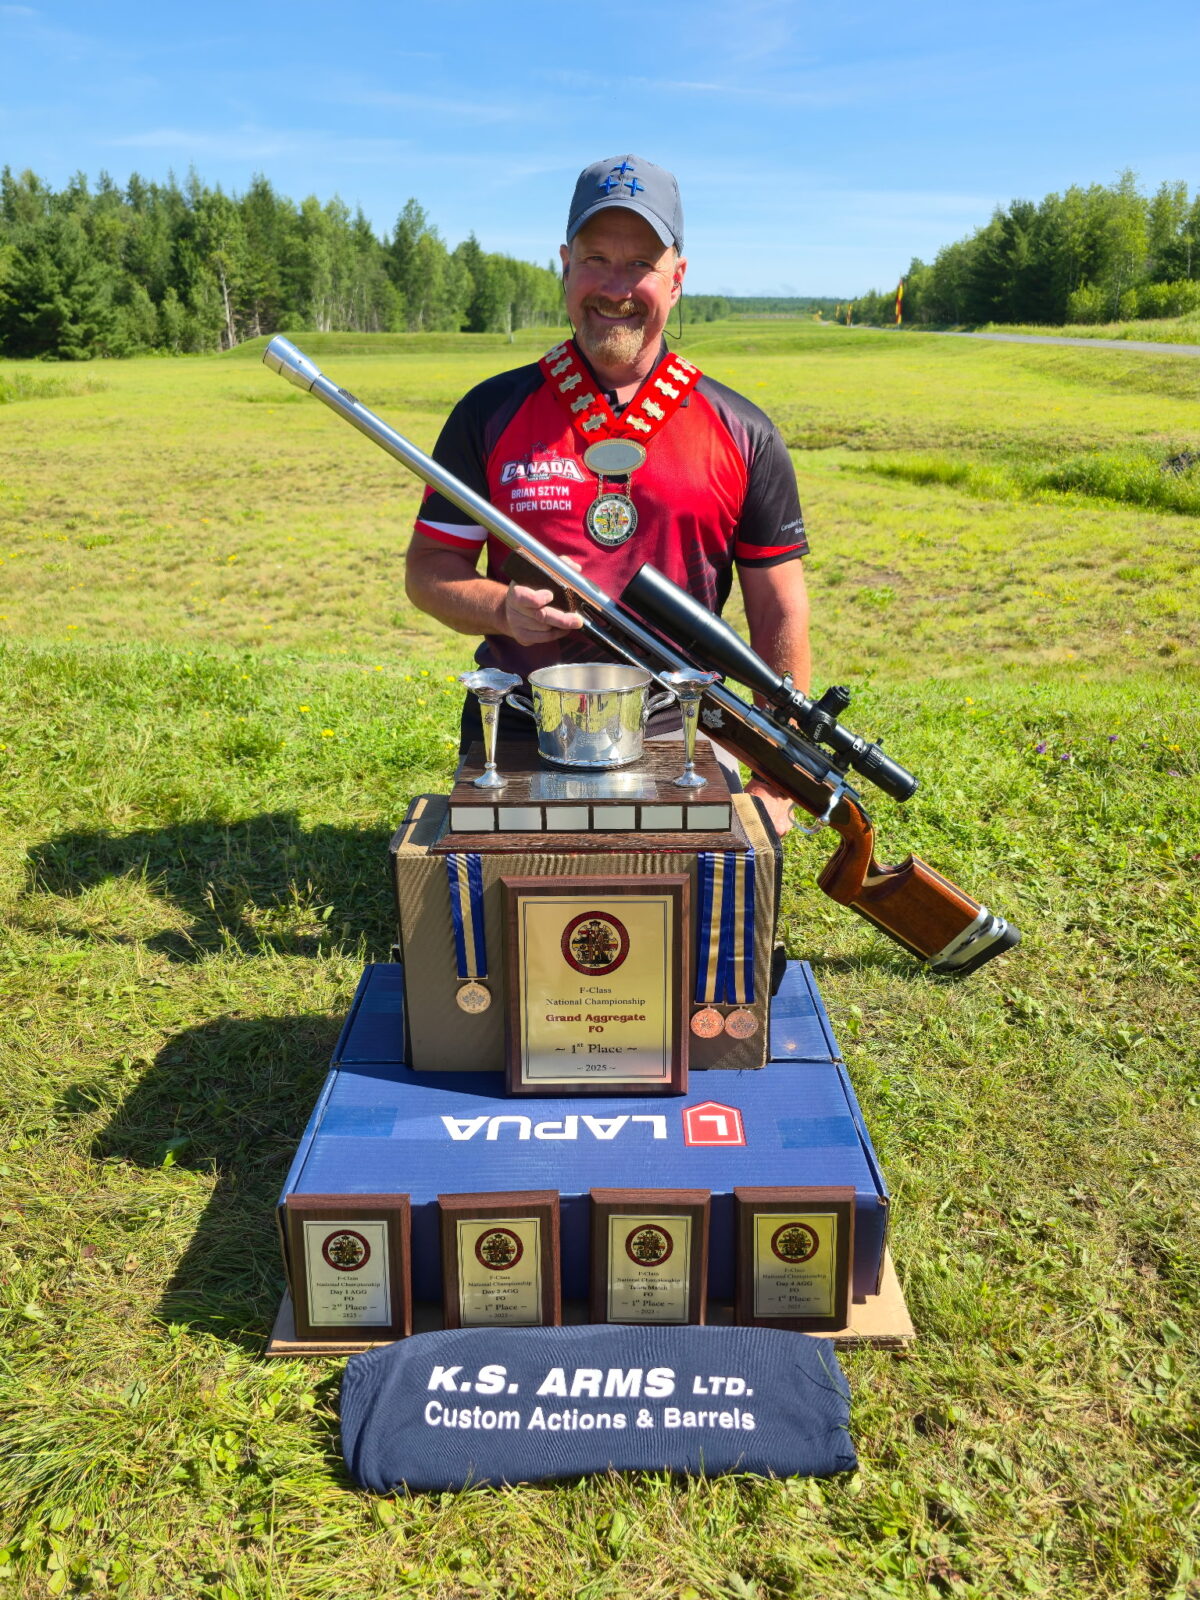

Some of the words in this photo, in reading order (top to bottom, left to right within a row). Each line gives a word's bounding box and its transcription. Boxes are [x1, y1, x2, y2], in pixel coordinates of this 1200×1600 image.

[501, 459, 584, 485] CANADA
[511, 487, 535, 499] BRIAN
[538, 486, 570, 497] SZTYM
[510, 503, 515, 513] F
[516, 501, 537, 512] OPEN
[540, 500, 572, 511] COACH
[579, 986, 612, 994] F-Class
[546, 998, 582, 1006] National
[584, 997, 646, 1007] Championship
[546, 1014, 582, 1022] Grand
[585, 1014, 646, 1024] Aggregate
[588, 1025, 604, 1033] FO
[571, 1042, 584, 1054] 1st
[588, 1043, 623, 1054] Place
[585, 1064, 607, 1072] 2025
[441, 1115, 667, 1141] LAPUA
[427, 1364, 519, 1395] K.S.
[535, 1367, 677, 1398] ARMS
[692, 1375, 754, 1397] LTD.
[424, 1401, 521, 1430] Custom
[527, 1407, 627, 1431] Actions
[636, 1409, 655, 1428] &
[663, 1407, 757, 1431] Barrels
